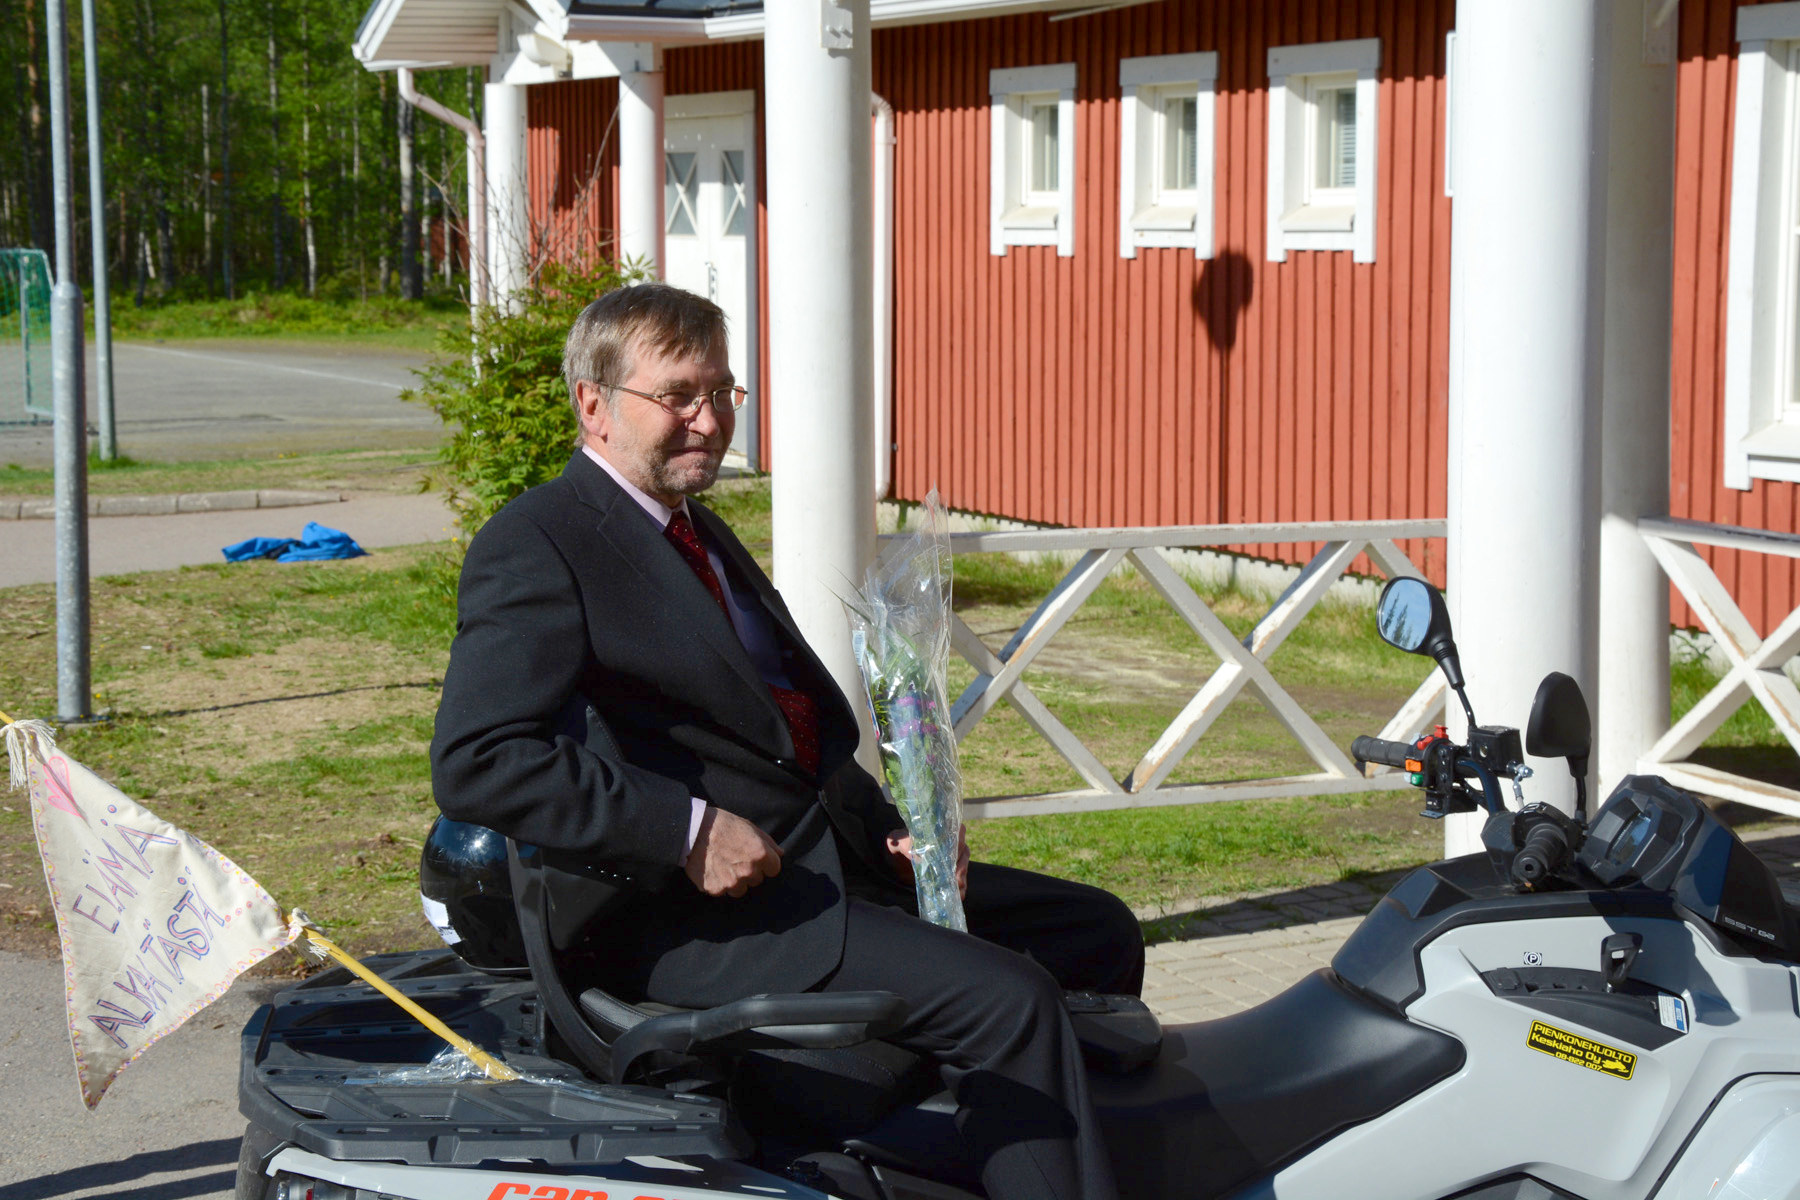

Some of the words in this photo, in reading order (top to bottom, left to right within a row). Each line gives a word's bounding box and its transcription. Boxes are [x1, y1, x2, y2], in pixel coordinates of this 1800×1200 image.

[1534, 1023, 1632, 1063] PIENKONEHUOLTO
[1585, 1051, 1602, 1064] Oy
[1585, 1062, 1603, 1072] 007
